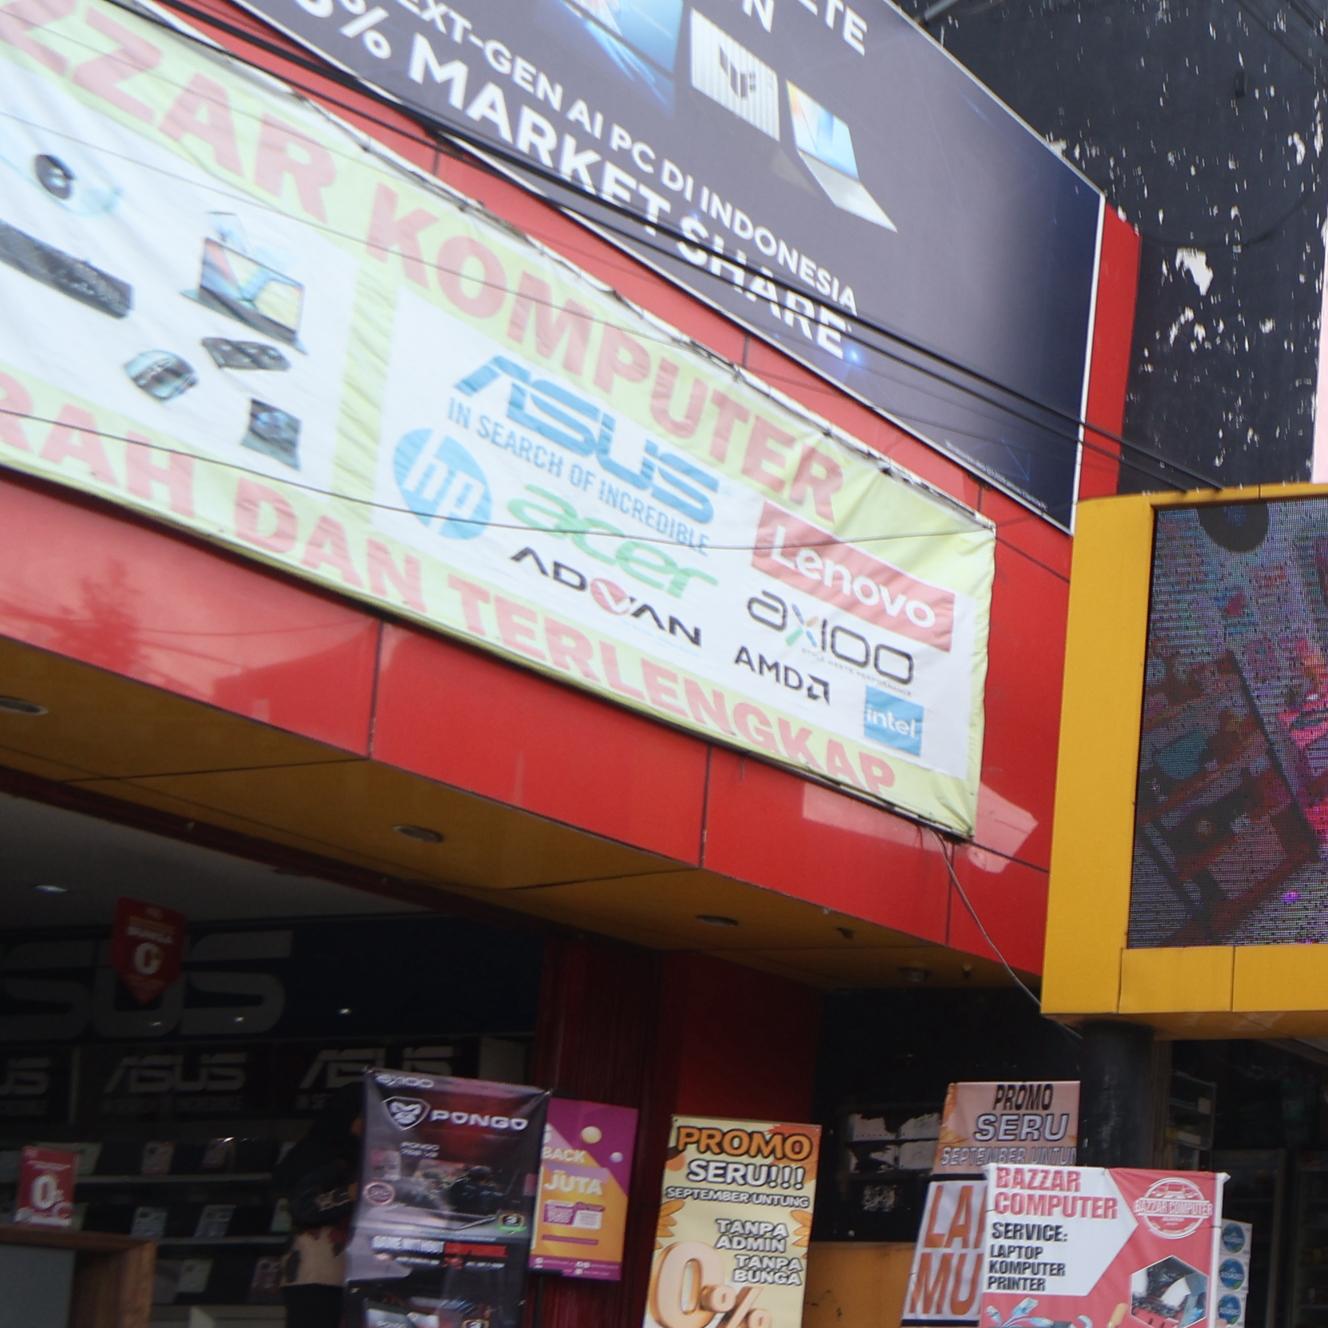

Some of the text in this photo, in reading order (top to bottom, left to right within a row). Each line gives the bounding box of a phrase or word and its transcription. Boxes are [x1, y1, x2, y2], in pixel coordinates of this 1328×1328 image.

[408, 32, 671, 236] MARKET
[566, 98, 603, 139] AI
[610, 123, 656, 174] PC
[660, 158, 693, 202] DI
[700, 185, 858, 317] INDONESIA
[365, 183, 844, 525] KOMPUTER
[453, 355, 720, 525] ASUS
[448, 397, 710, 557] IN SEARCH OF INCREDIBLE
[506, 483, 720, 599] acer
[769, 525, 936, 629] Lenovo
[510, 546, 702, 647] ADVAN
[234, 477, 429, 613] DAN
[447, 573, 897, 796] TERLENGKAP
[734, 645, 805, 691] AMD
[866, 705, 916, 738] intel
[993, 1083, 1055, 1112] PROMO
[428, 1108, 530, 1132] PONGO
[973, 1113, 1070, 1143] SERU
[677, 1125, 814, 1162] PROMO
[686, 1158, 806, 1191] SERU!!!
[994, 1166, 1082, 1193] BAZZAR
[665, 1186, 810, 1208] SEPTEMBER UNTUNG
[994, 1192, 1119, 1220] COMPUTER
[715, 1218, 789, 1239] TANPA
[991, 1221, 1068, 1243] SERVICE:
[715, 1235, 787, 1253] ADMIN
[989, 1244, 1044, 1260] LAPTOP
[733, 1269, 803, 1286] BUNGA
[735, 1254, 803, 1272] TANPA
[988, 1260, 1067, 1277] KOMPUTER
[986, 1276, 1047, 1292] PRINTER
